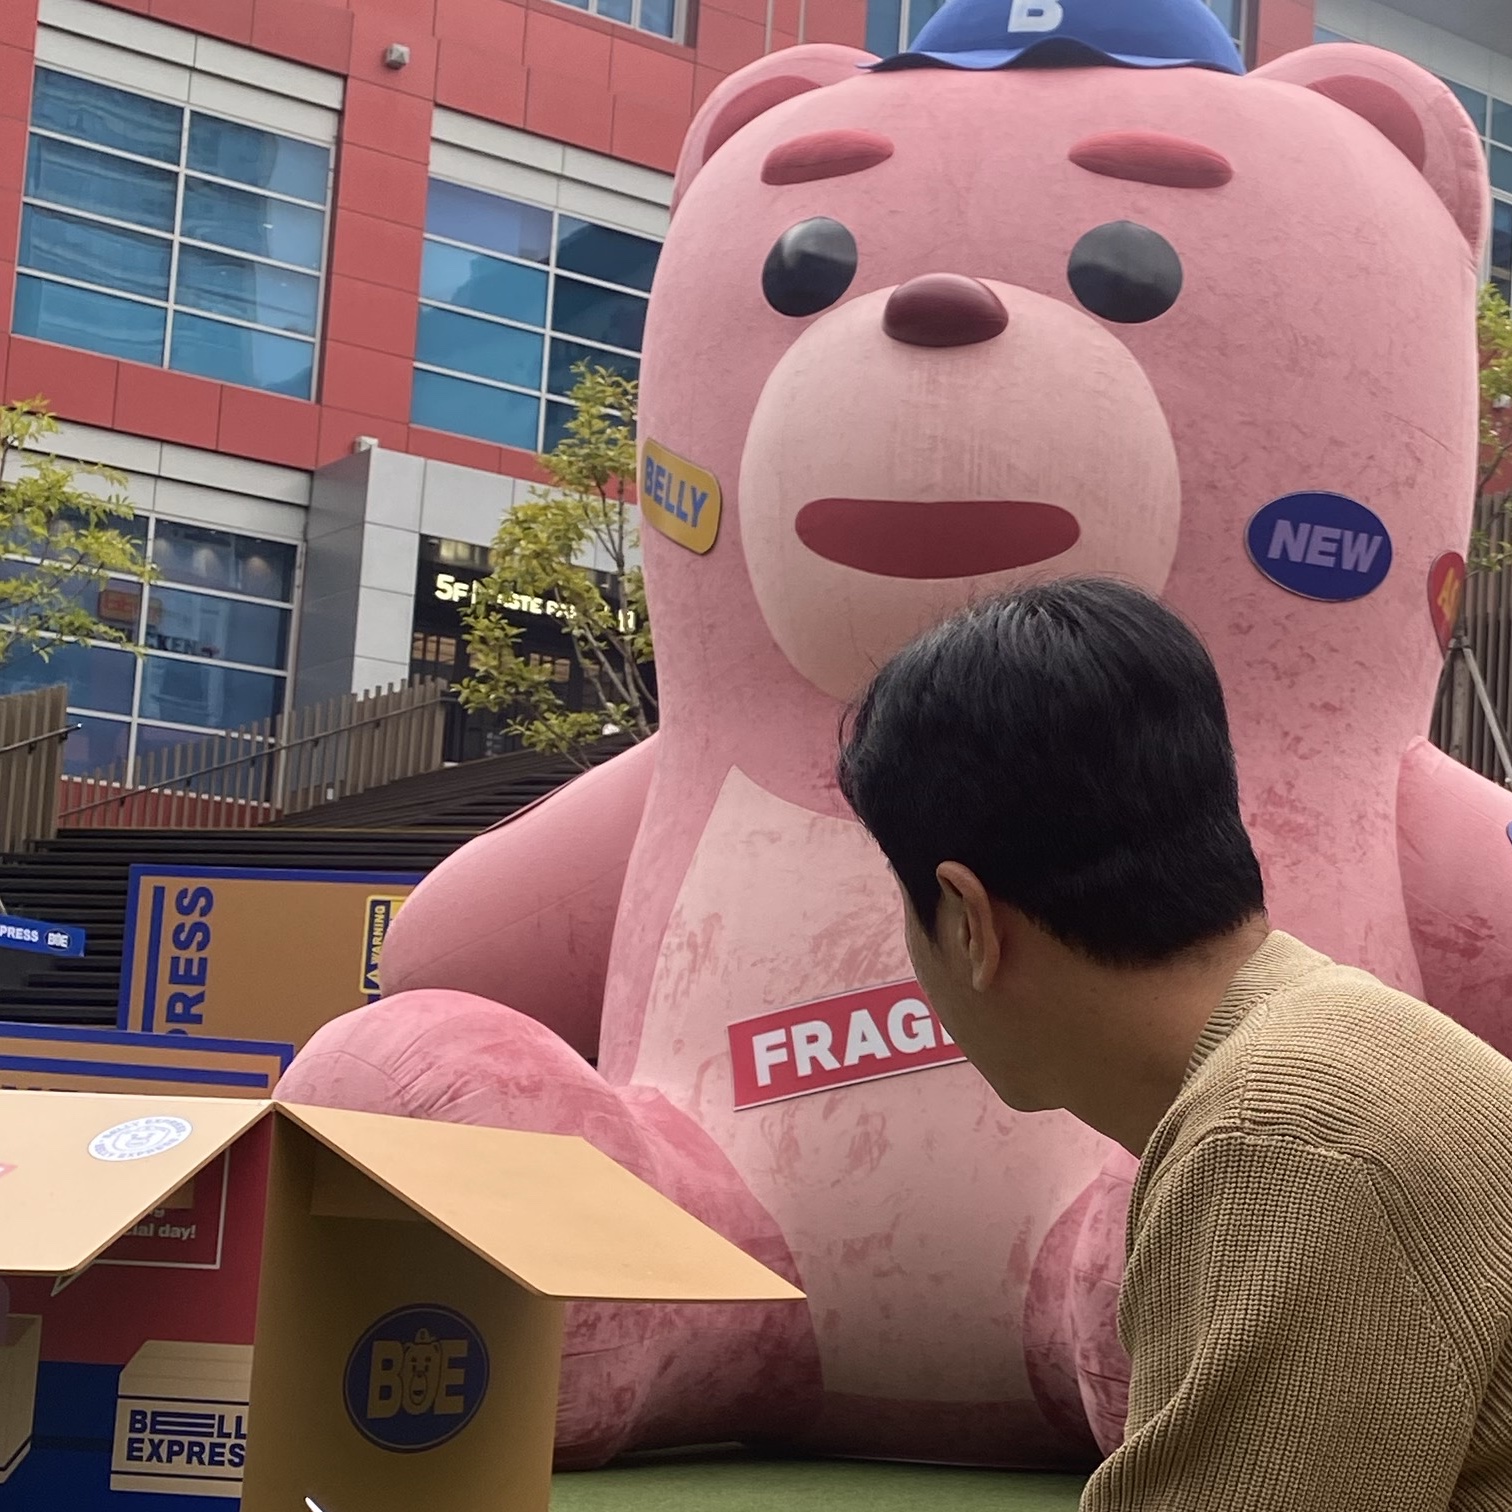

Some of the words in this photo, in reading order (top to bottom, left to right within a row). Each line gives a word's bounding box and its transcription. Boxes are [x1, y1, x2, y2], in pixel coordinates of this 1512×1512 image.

[644, 455, 709, 529] BELLY
[1267, 518, 1383, 574] NEW
[0, 925, 39, 942] PRESS
[165, 886, 214, 1035] RESS
[158, 1224, 196, 1240] day!
[128, 1409, 248, 1440] BELL
[126, 1437, 246, 1468] EXPRES
